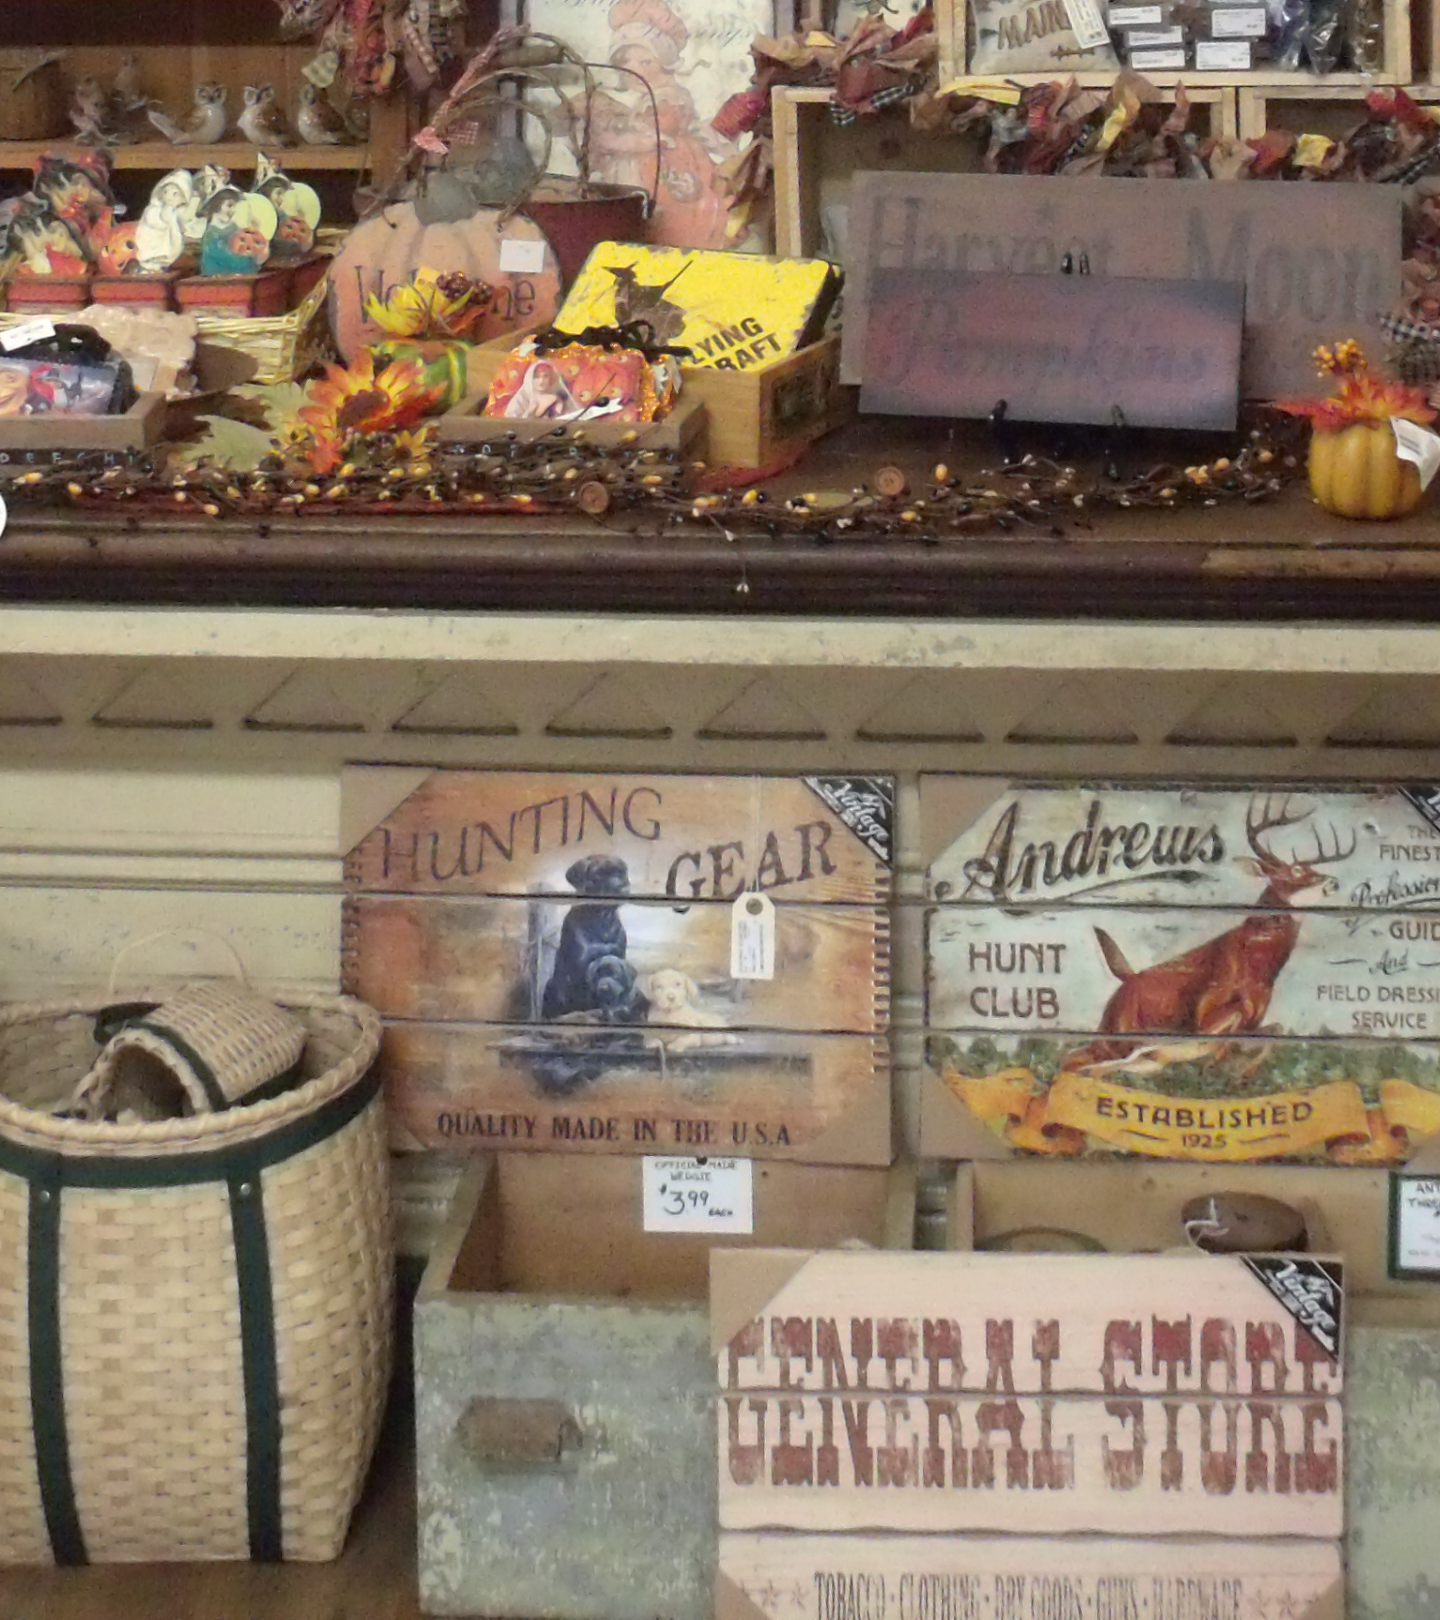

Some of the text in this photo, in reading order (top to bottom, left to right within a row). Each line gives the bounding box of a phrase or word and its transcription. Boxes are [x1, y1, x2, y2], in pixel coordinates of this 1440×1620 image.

[681, 316, 766, 368] LYING
[377, 785, 662, 884] HUNTING
[950, 800, 1224, 900] Andrews
[665, 819, 838, 904] GEAR
[968, 942, 1067, 974] HUNT
[969, 986, 1061, 1019] CLUB
[1316, 986, 1371, 1003] FIELD
[1350, 1011, 1428, 1030] SERVICE
[436, 1111, 537, 1141] QUALITY
[550, 1114, 621, 1143] MADE
[632, 1116, 658, 1143] IN
[671, 1117, 719, 1145] THE
[1095, 1096, 1314, 1130] ESTABLISHED
[1180, 1133, 1228, 1150] 1925
[727, 1313, 1339, 1496] GENERAL STORE
[813, 1571, 887, 1620] TOBACCO
[899, 1571, 981, 1620] CLOTHING
